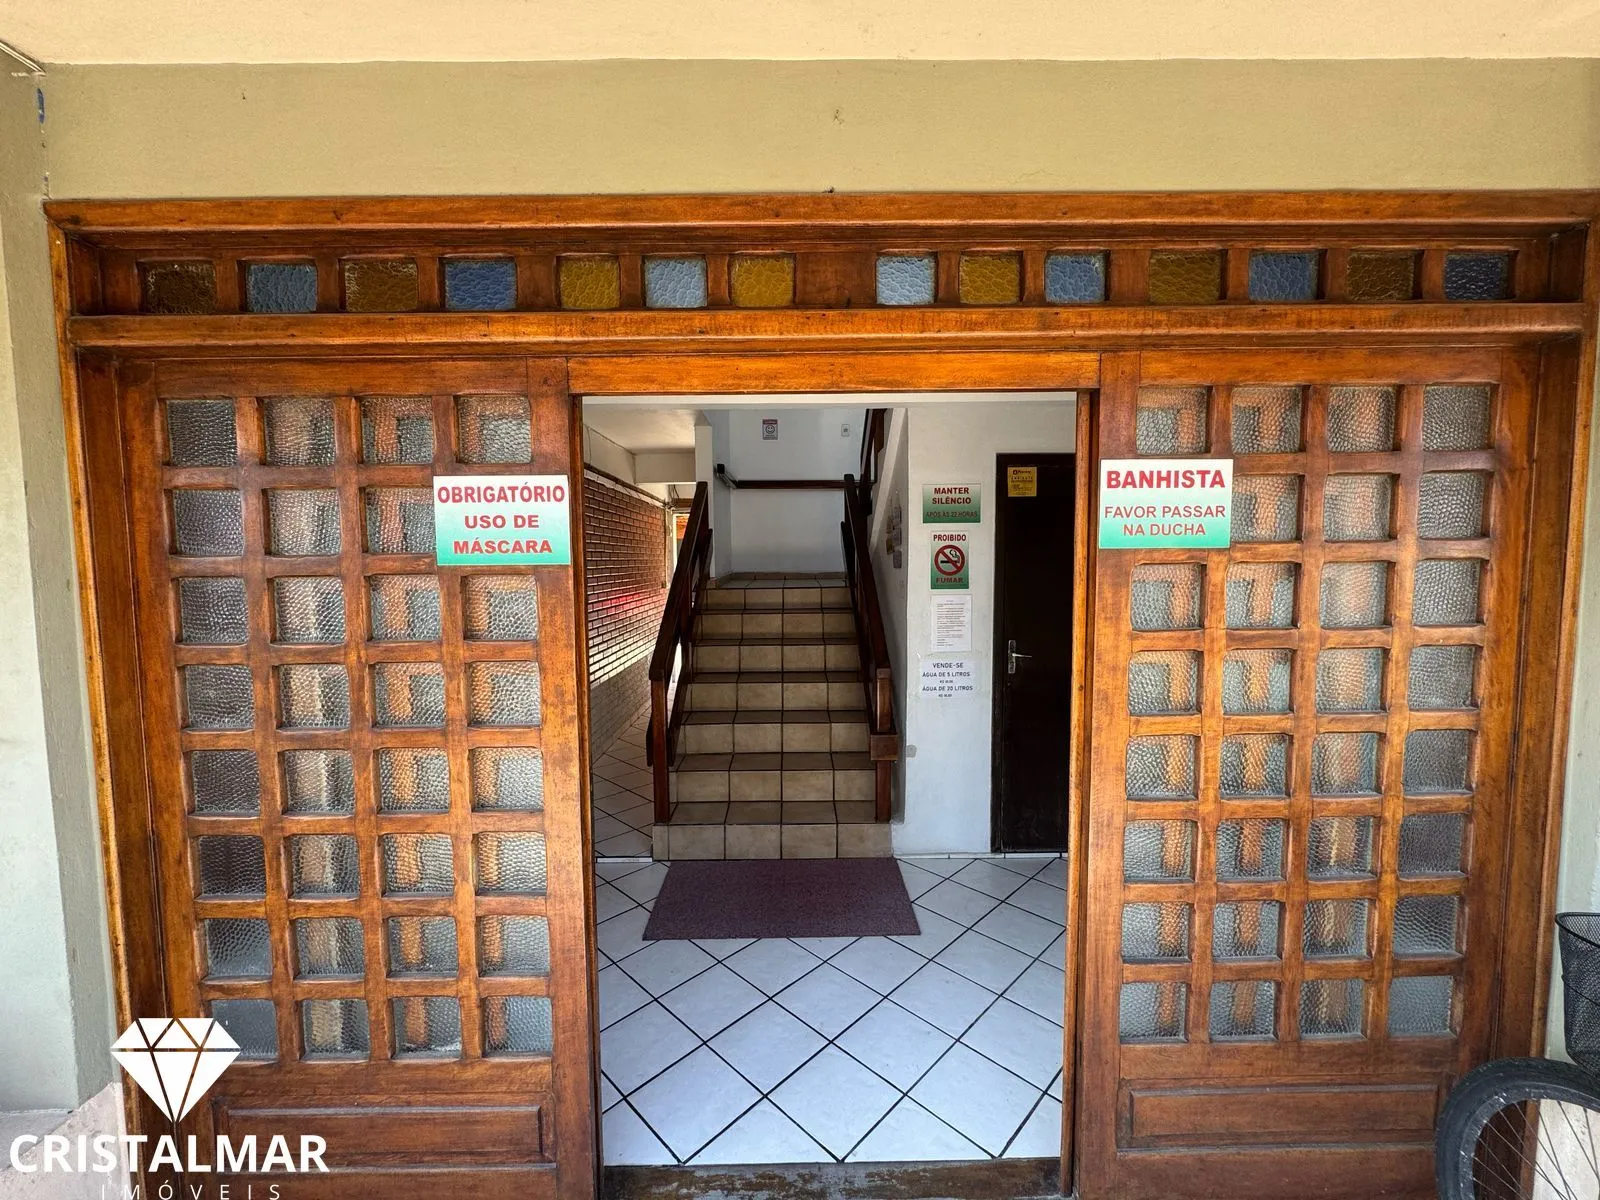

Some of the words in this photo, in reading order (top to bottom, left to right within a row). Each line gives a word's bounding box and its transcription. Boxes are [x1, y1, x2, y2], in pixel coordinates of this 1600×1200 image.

[1106, 470, 1225, 488] BANHISTA
[437, 481, 565, 503] OBRIGATÓRIO
[932, 496, 971, 504] SILÊNCIO
[1104, 506, 1157, 518] FAVOR
[1162, 505, 1226, 518] PASSAR
[465, 515, 506, 529] USO
[514, 515, 540, 528] DE
[1123, 524, 1145, 536] NA
[1150, 523, 1206, 536] DUCHA
[453, 537, 553, 554] MÁSCARA
